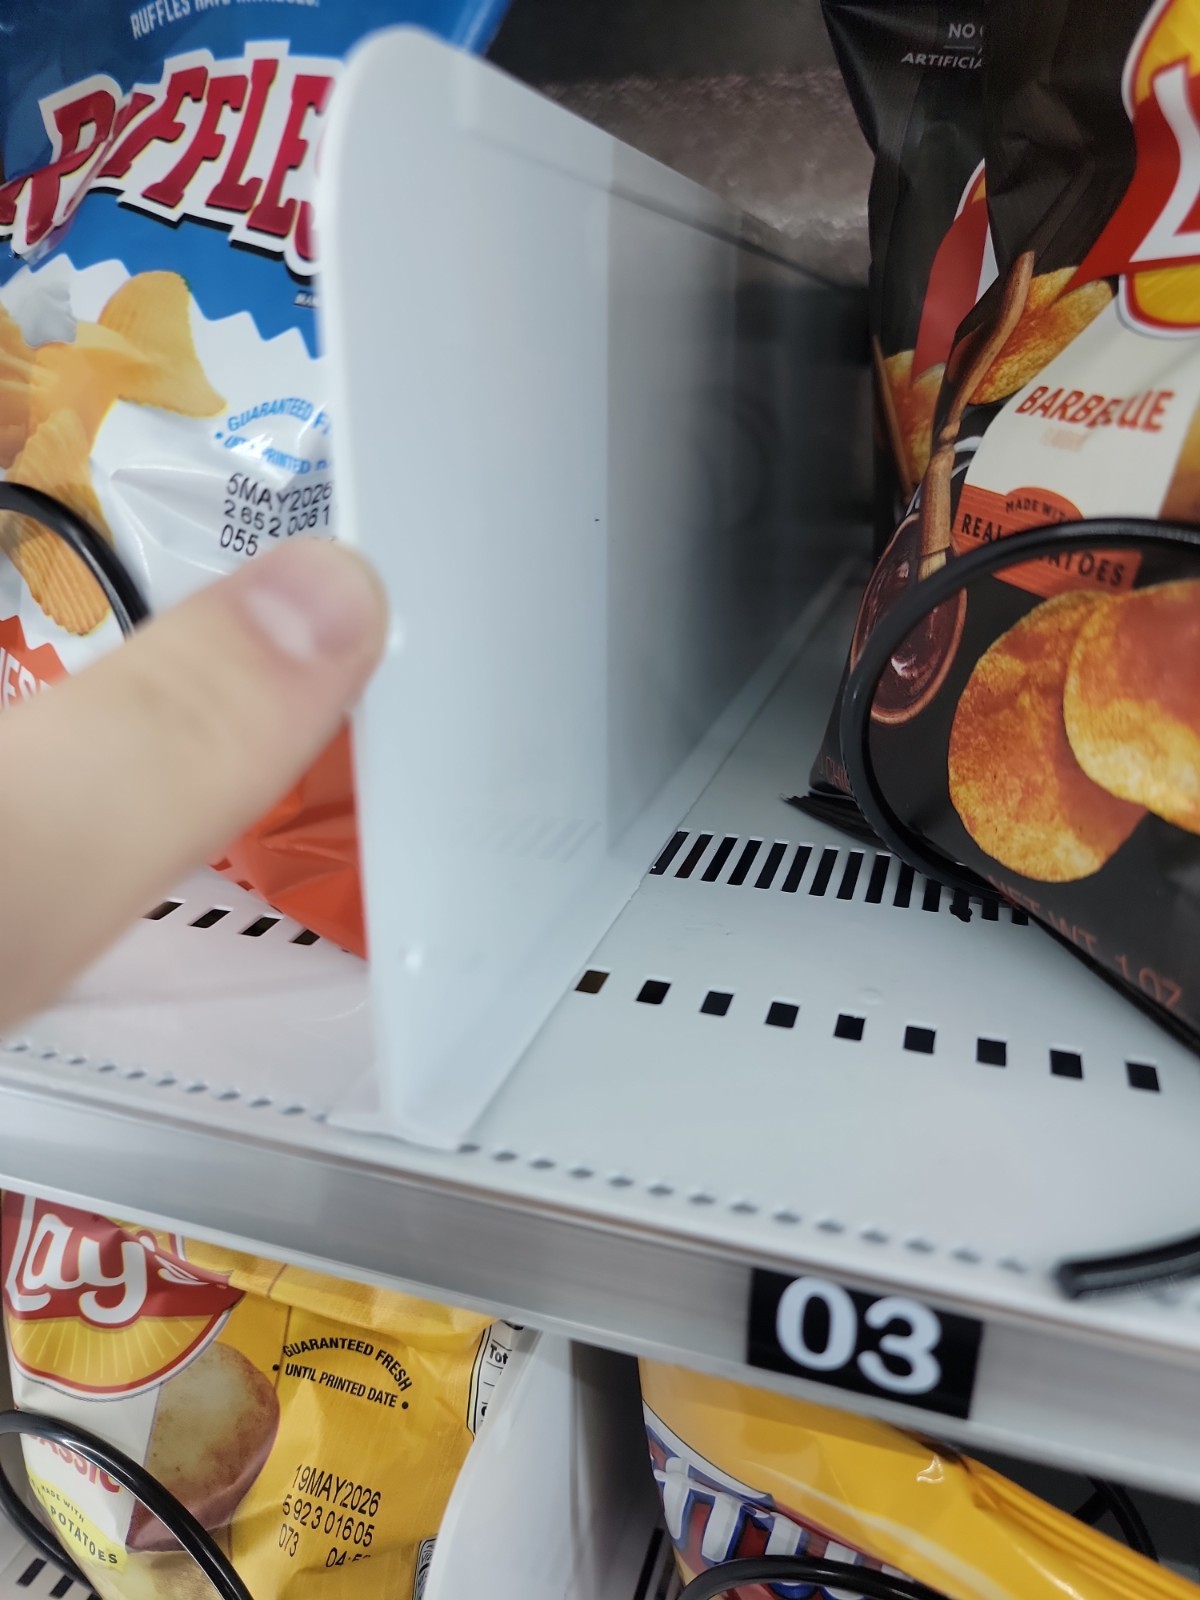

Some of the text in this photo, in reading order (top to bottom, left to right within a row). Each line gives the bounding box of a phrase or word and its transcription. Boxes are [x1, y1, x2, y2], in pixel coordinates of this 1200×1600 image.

[948, 23, 976, 39] NO
[0, 58, 334, 264] RFFLE
[1005, 496, 1038, 513] MADE
[221, 524, 259, 556] 055
[776, 1276, 942, 1395] 03
[282, 1337, 413, 1392] GUARANTEED FRESH
[285, 1363, 398, 1408] UNTIL PRINTED DATE
[292, 1464, 381, 1517] 19MAY2026
[50, 1506, 118, 1564] POTATOES
[278, 1523, 300, 1558] 073
